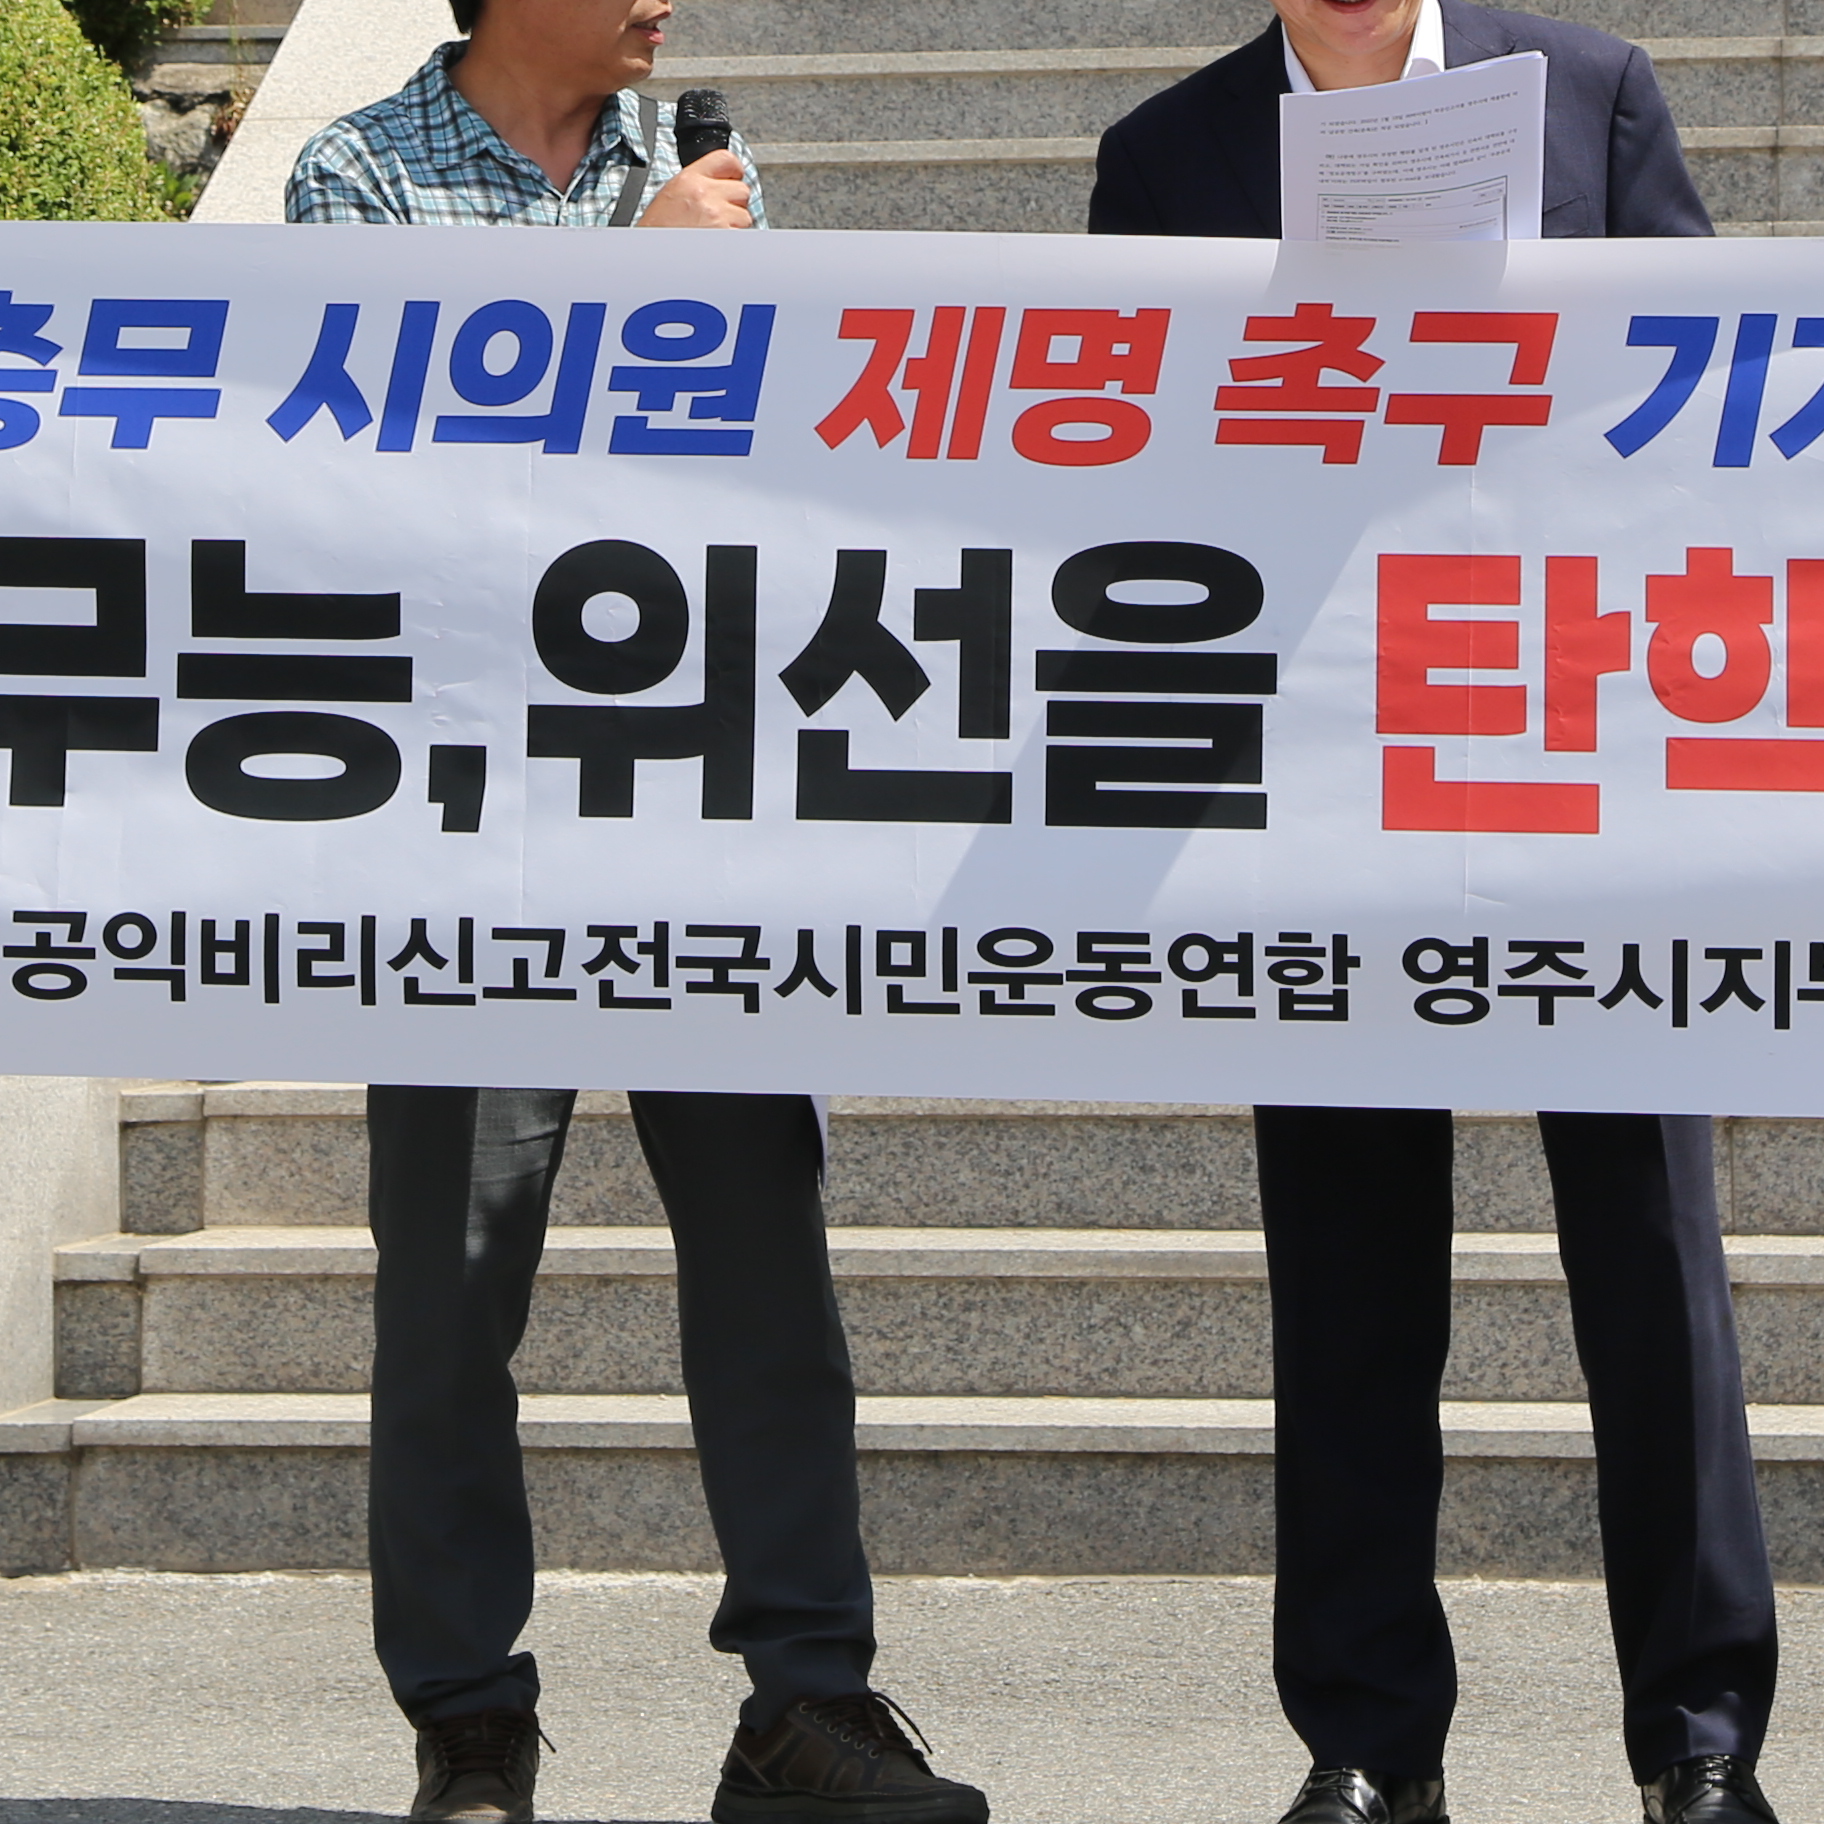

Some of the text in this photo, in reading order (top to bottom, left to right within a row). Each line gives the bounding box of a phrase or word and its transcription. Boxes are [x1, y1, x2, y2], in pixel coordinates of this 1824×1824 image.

[266, 299, 777, 456] 시의원
[814, 306, 1172, 467] 제명
[1213, 302, 1560, 467] 촉구
